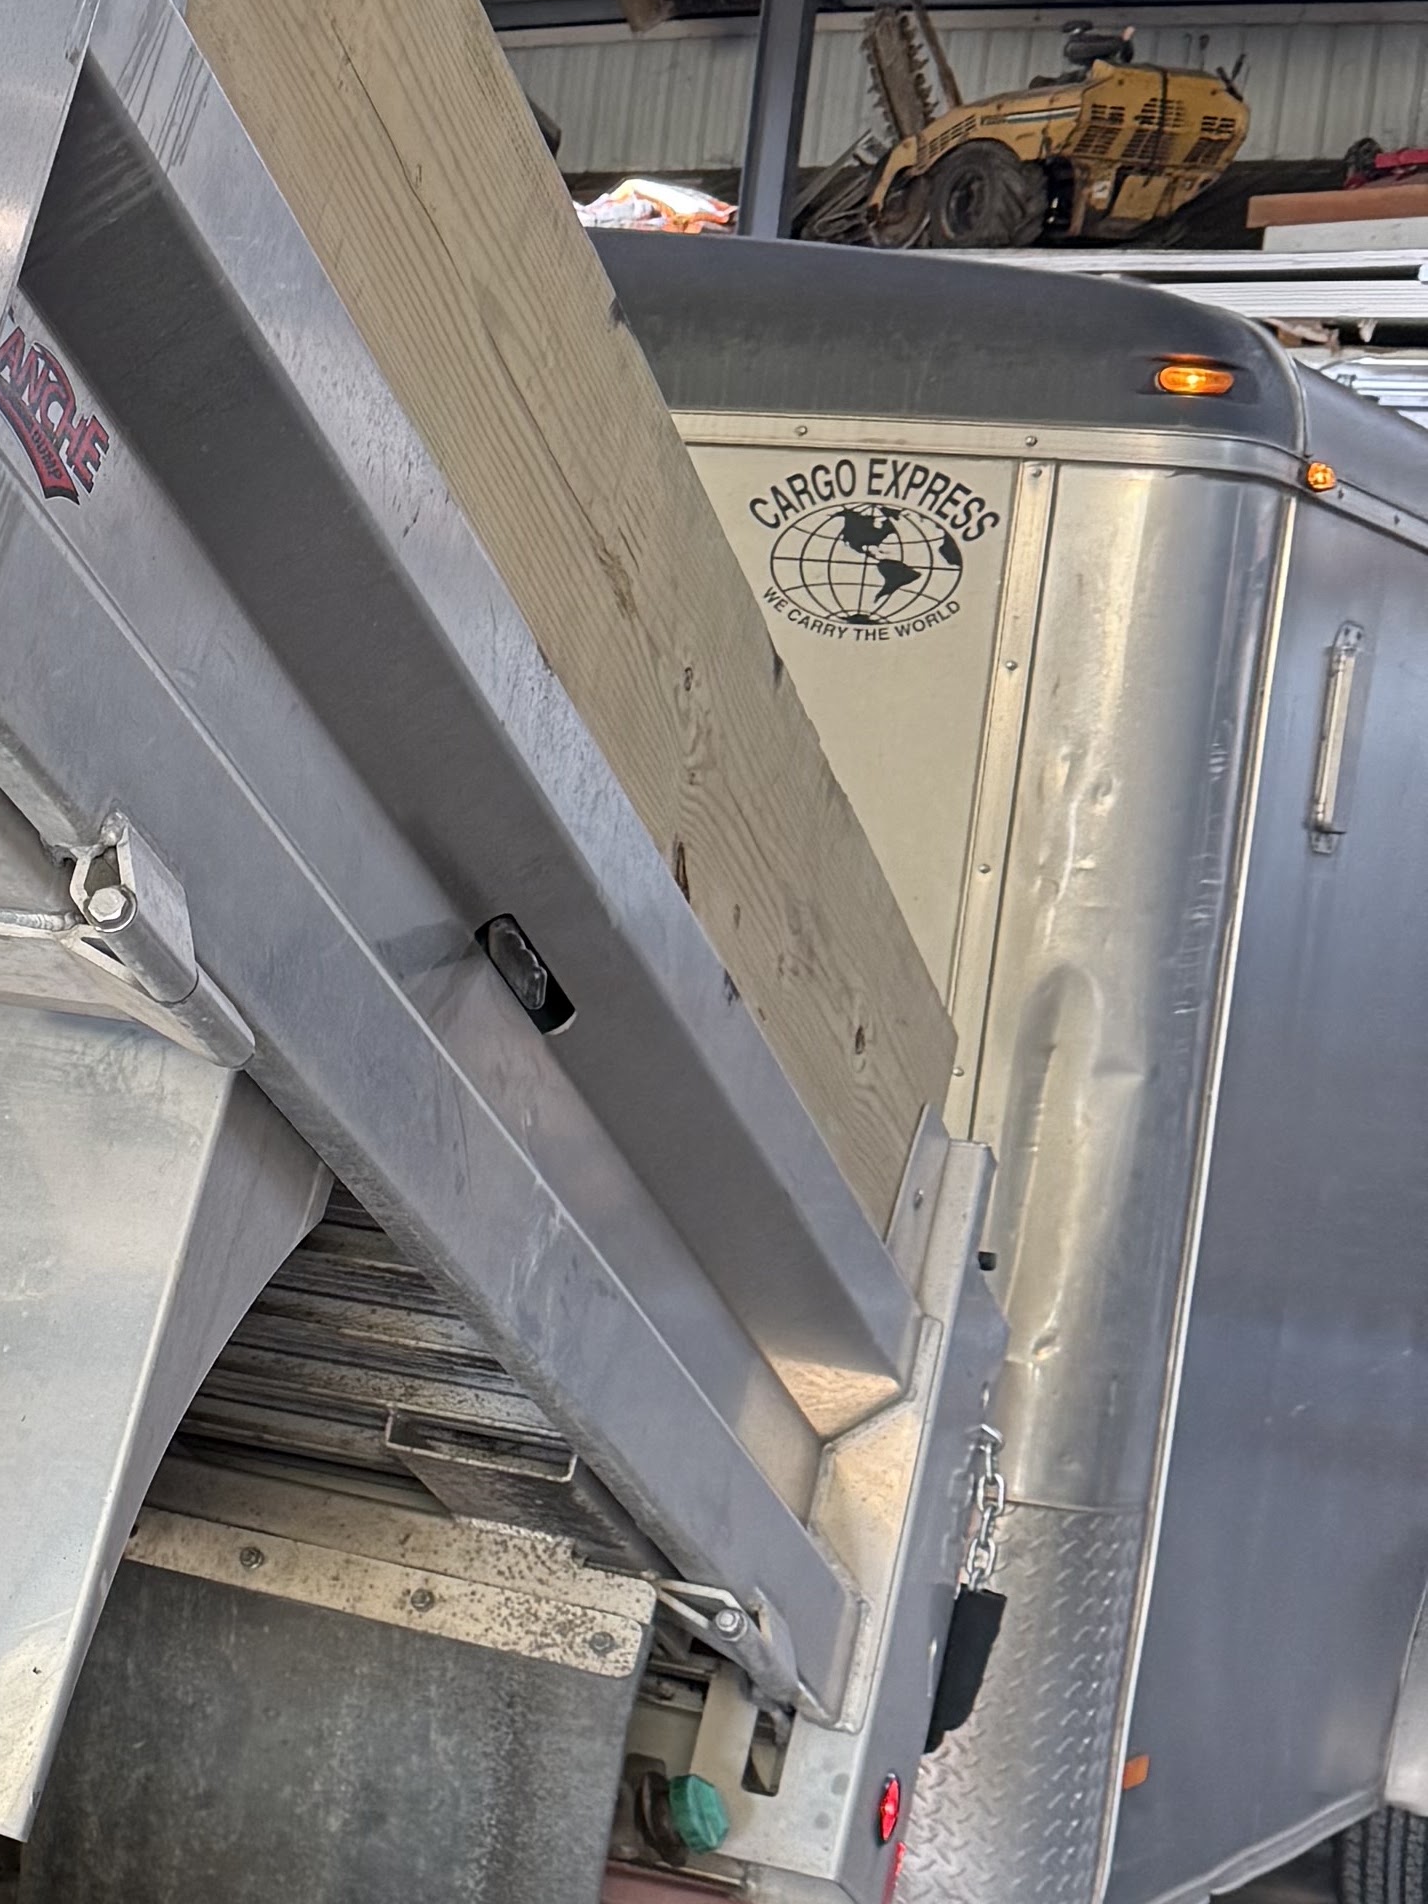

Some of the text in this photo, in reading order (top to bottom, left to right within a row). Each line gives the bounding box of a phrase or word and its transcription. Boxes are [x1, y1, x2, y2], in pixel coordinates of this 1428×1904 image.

[749, 458, 1000, 542] CARGO EXPRESS
[763, 586, 961, 641] WE CARRY THE WORLD
